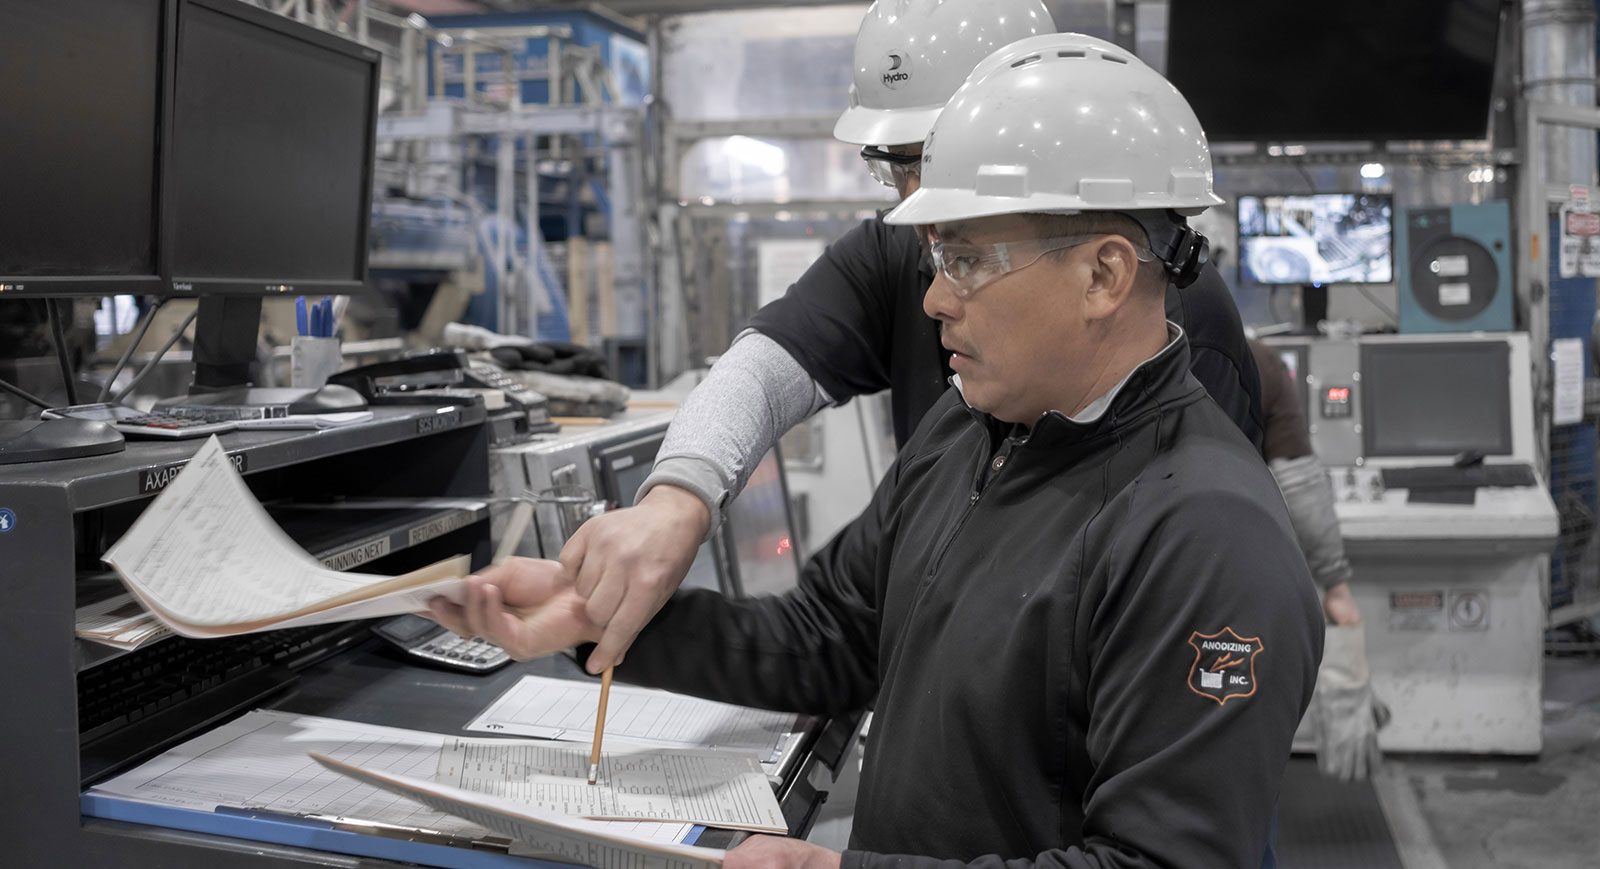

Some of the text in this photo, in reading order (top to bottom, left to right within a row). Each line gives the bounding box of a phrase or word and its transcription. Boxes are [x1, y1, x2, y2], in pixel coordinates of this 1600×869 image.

[883, 72, 908, 84] Hydro
[365, 541, 385, 560] NEXT
[1202, 640, 1252, 653] ANODIZING
[1229, 675, 1249, 685] INC.
